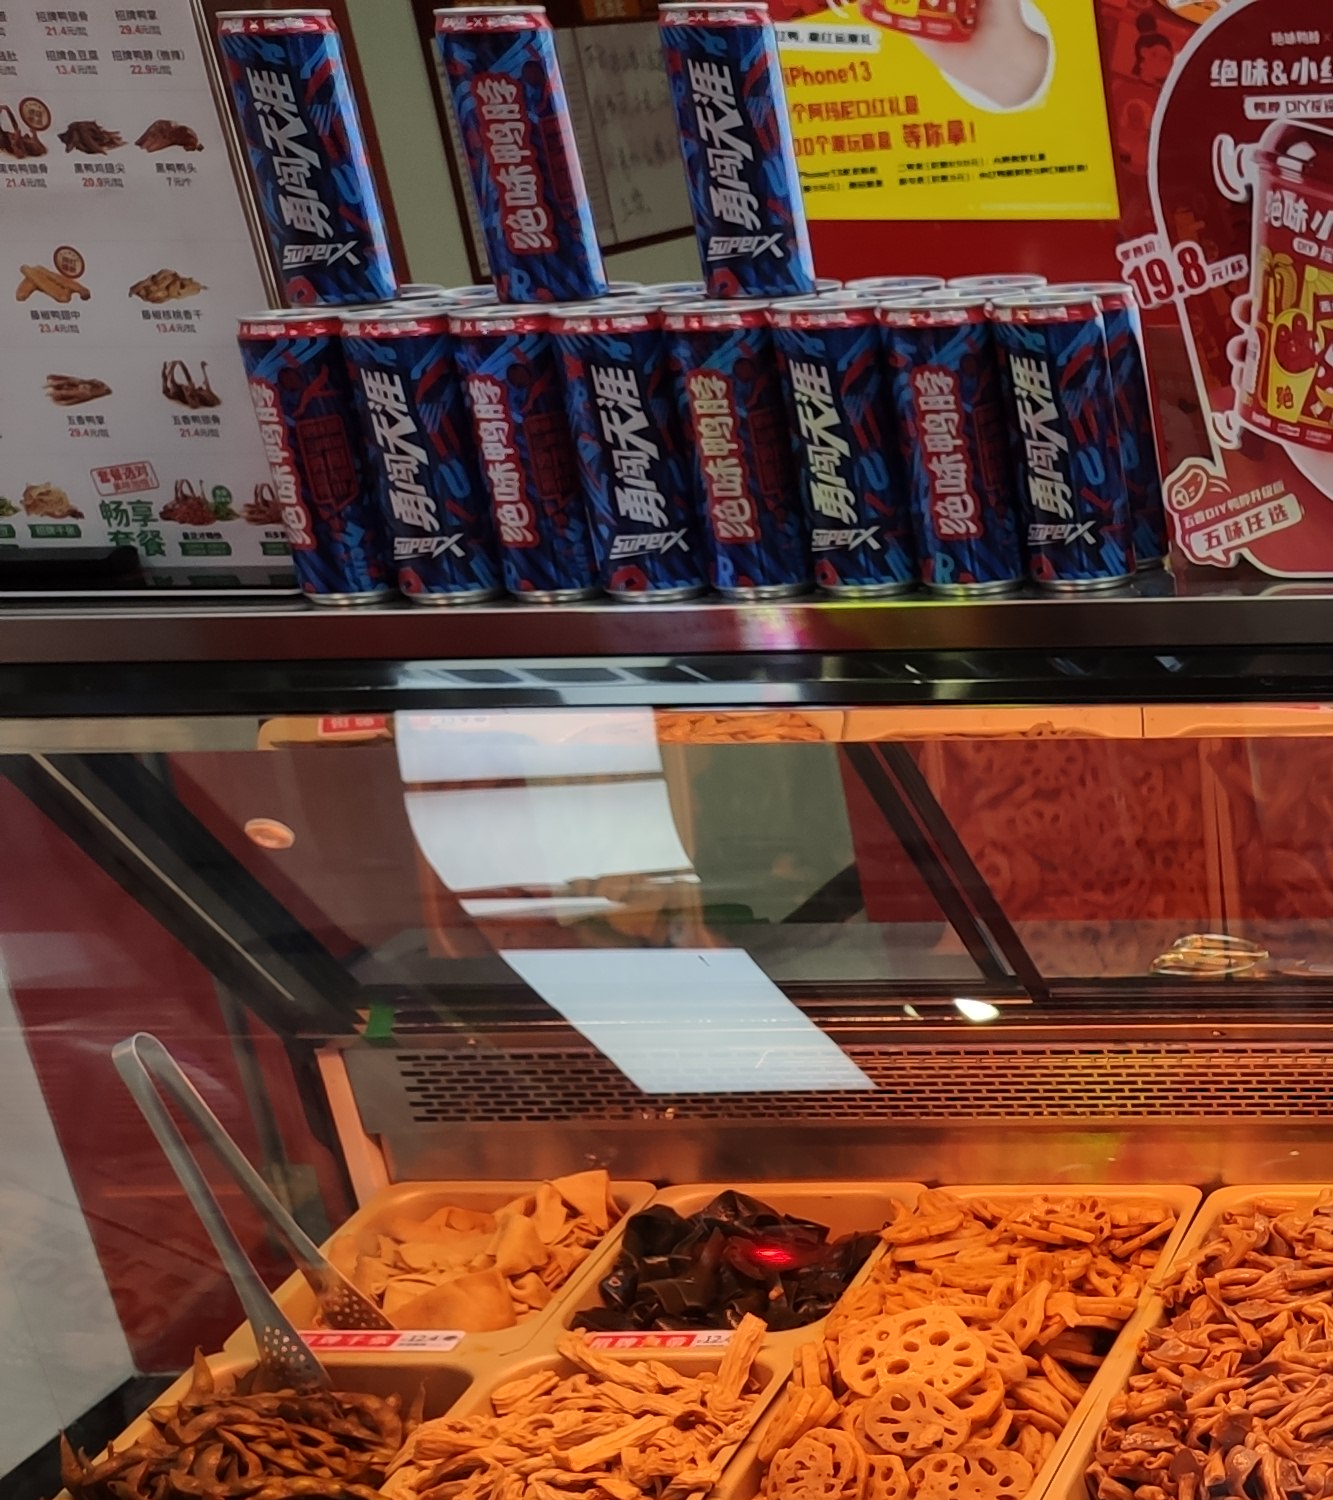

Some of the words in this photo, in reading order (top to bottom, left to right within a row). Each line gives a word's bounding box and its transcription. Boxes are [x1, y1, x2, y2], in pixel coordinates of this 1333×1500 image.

[246, 66, 335, 239] 勇闯天涯
[476, 77, 553, 252] 绝味鸭脖
[688, 59, 762, 230] 勇闯天涯
[1130, 246, 1206, 306] 19.8
[100, 500, 158, 527] 畅享
[252, 382, 311, 545] 绝味鸭脖
[360, 368, 440, 531] 勇闯天涯
[469, 379, 534, 542] 绝味鸭脖
[591, 364, 668, 528] 勇闯天涯
[690, 375, 754, 538] 绝味鸭脖
[787, 359, 858, 524] 勇闯天涯
[915, 371, 978, 535] 绝味鸭脖
[1010, 354, 1074, 519] 勇闯天涯
[1203, 504, 1289, 550] 五味任选
